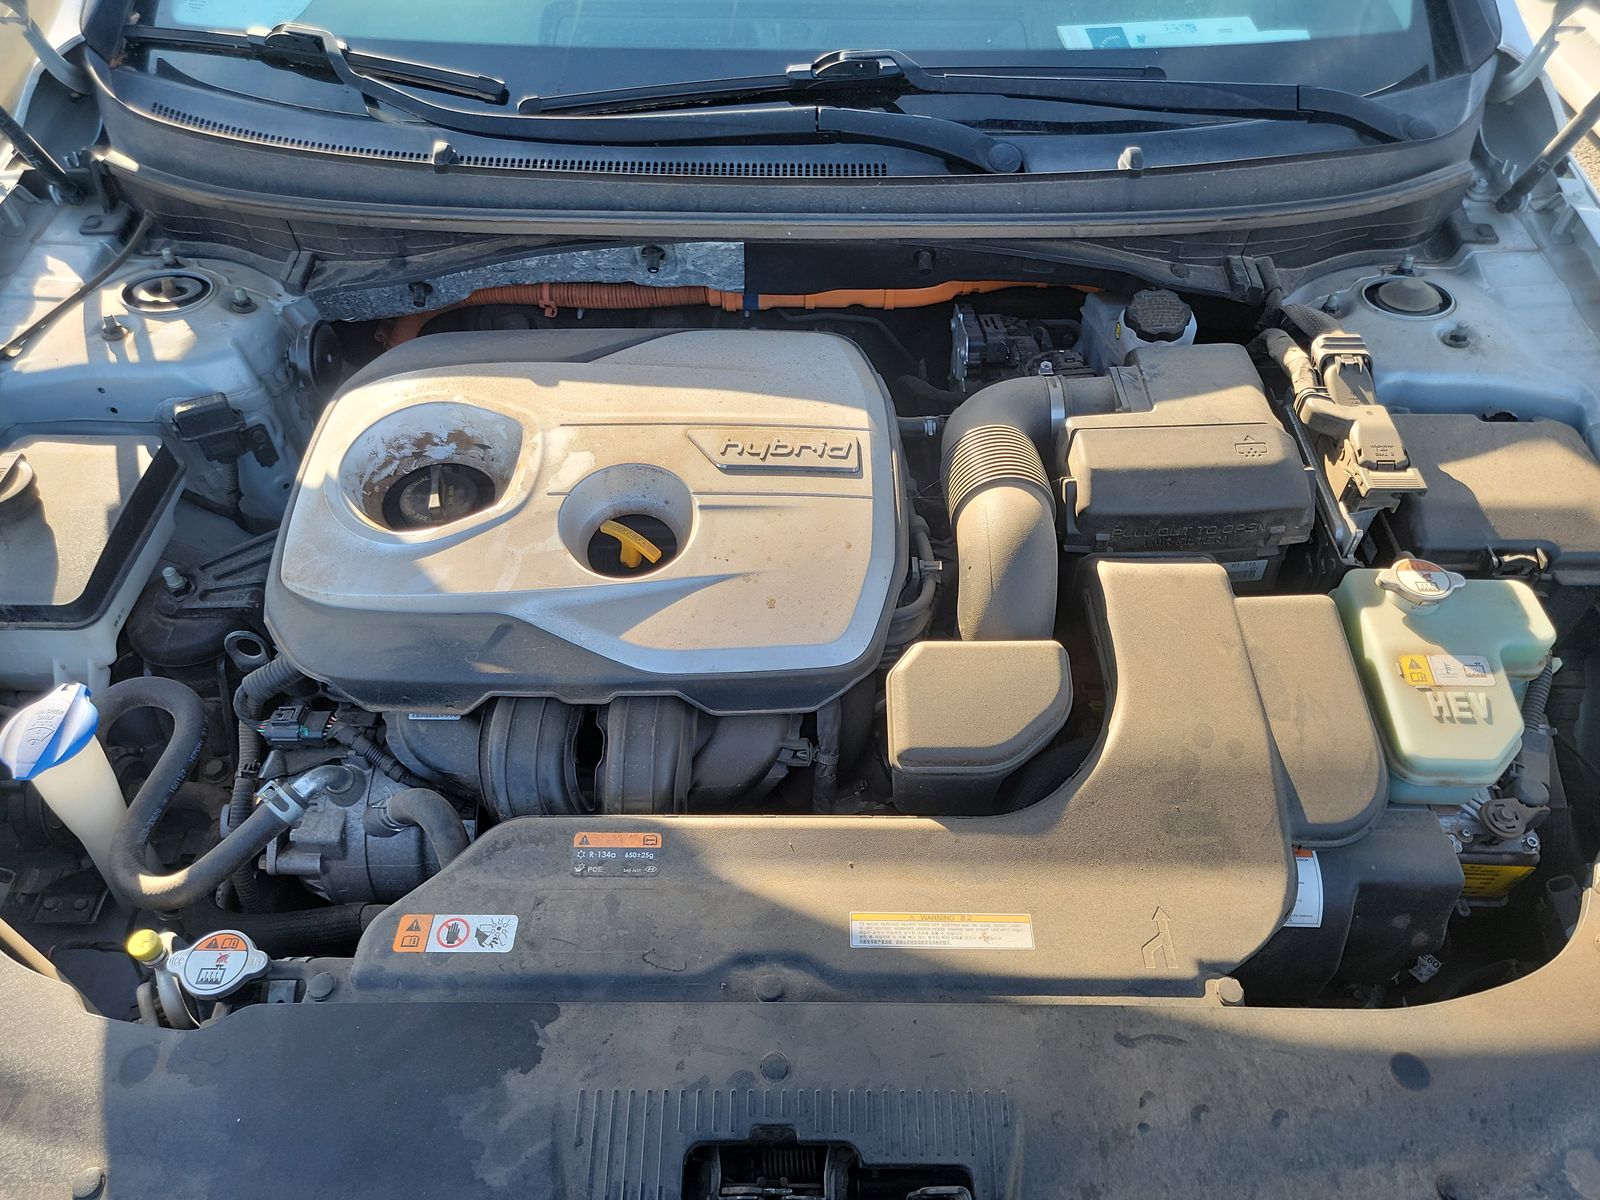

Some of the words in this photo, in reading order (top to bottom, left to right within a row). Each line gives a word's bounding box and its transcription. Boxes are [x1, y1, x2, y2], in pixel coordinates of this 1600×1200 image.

[719, 437, 853, 462] hybrid
[1158, 526, 1194, 537] OUT
[1197, 525, 1218, 535] TO
[1222, 521, 1269, 534] OPEN
[1426, 691, 1492, 724] HEV
[589, 850, 617, 859] R-134a
[624, 851, 654, 860] 650±25g
